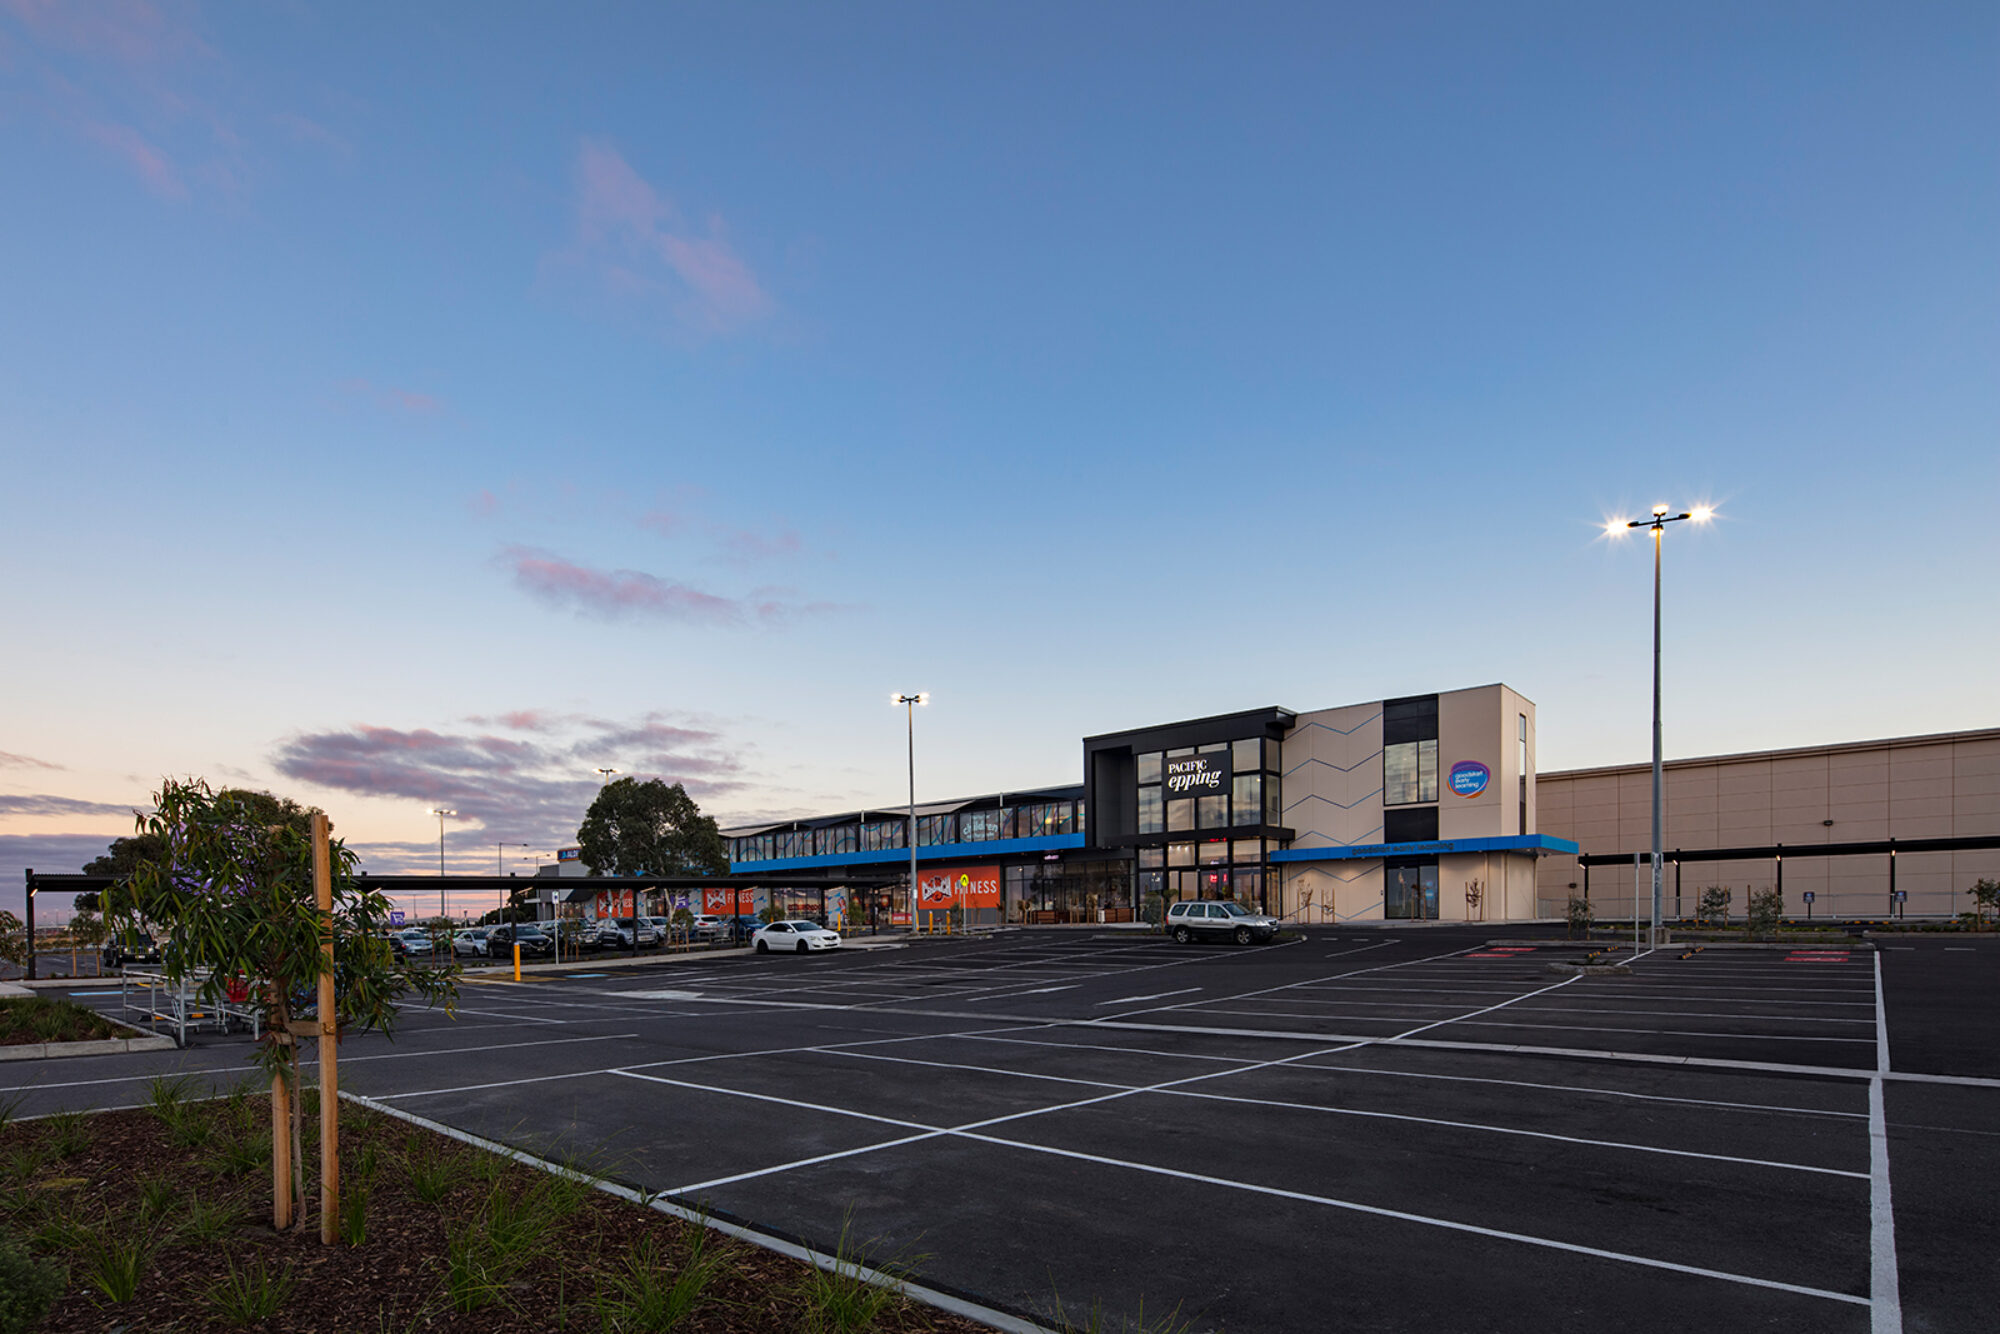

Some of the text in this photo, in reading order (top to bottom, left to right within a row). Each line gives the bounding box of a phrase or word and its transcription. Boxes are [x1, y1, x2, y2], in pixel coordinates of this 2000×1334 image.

[1168, 760, 1207, 774] PACIFIC
[1168, 770, 1221, 792] epping
[963, 819, 999, 835] children
[1352, 845, 1391, 856] goodstart
[1418, 842, 1455, 851] learning
